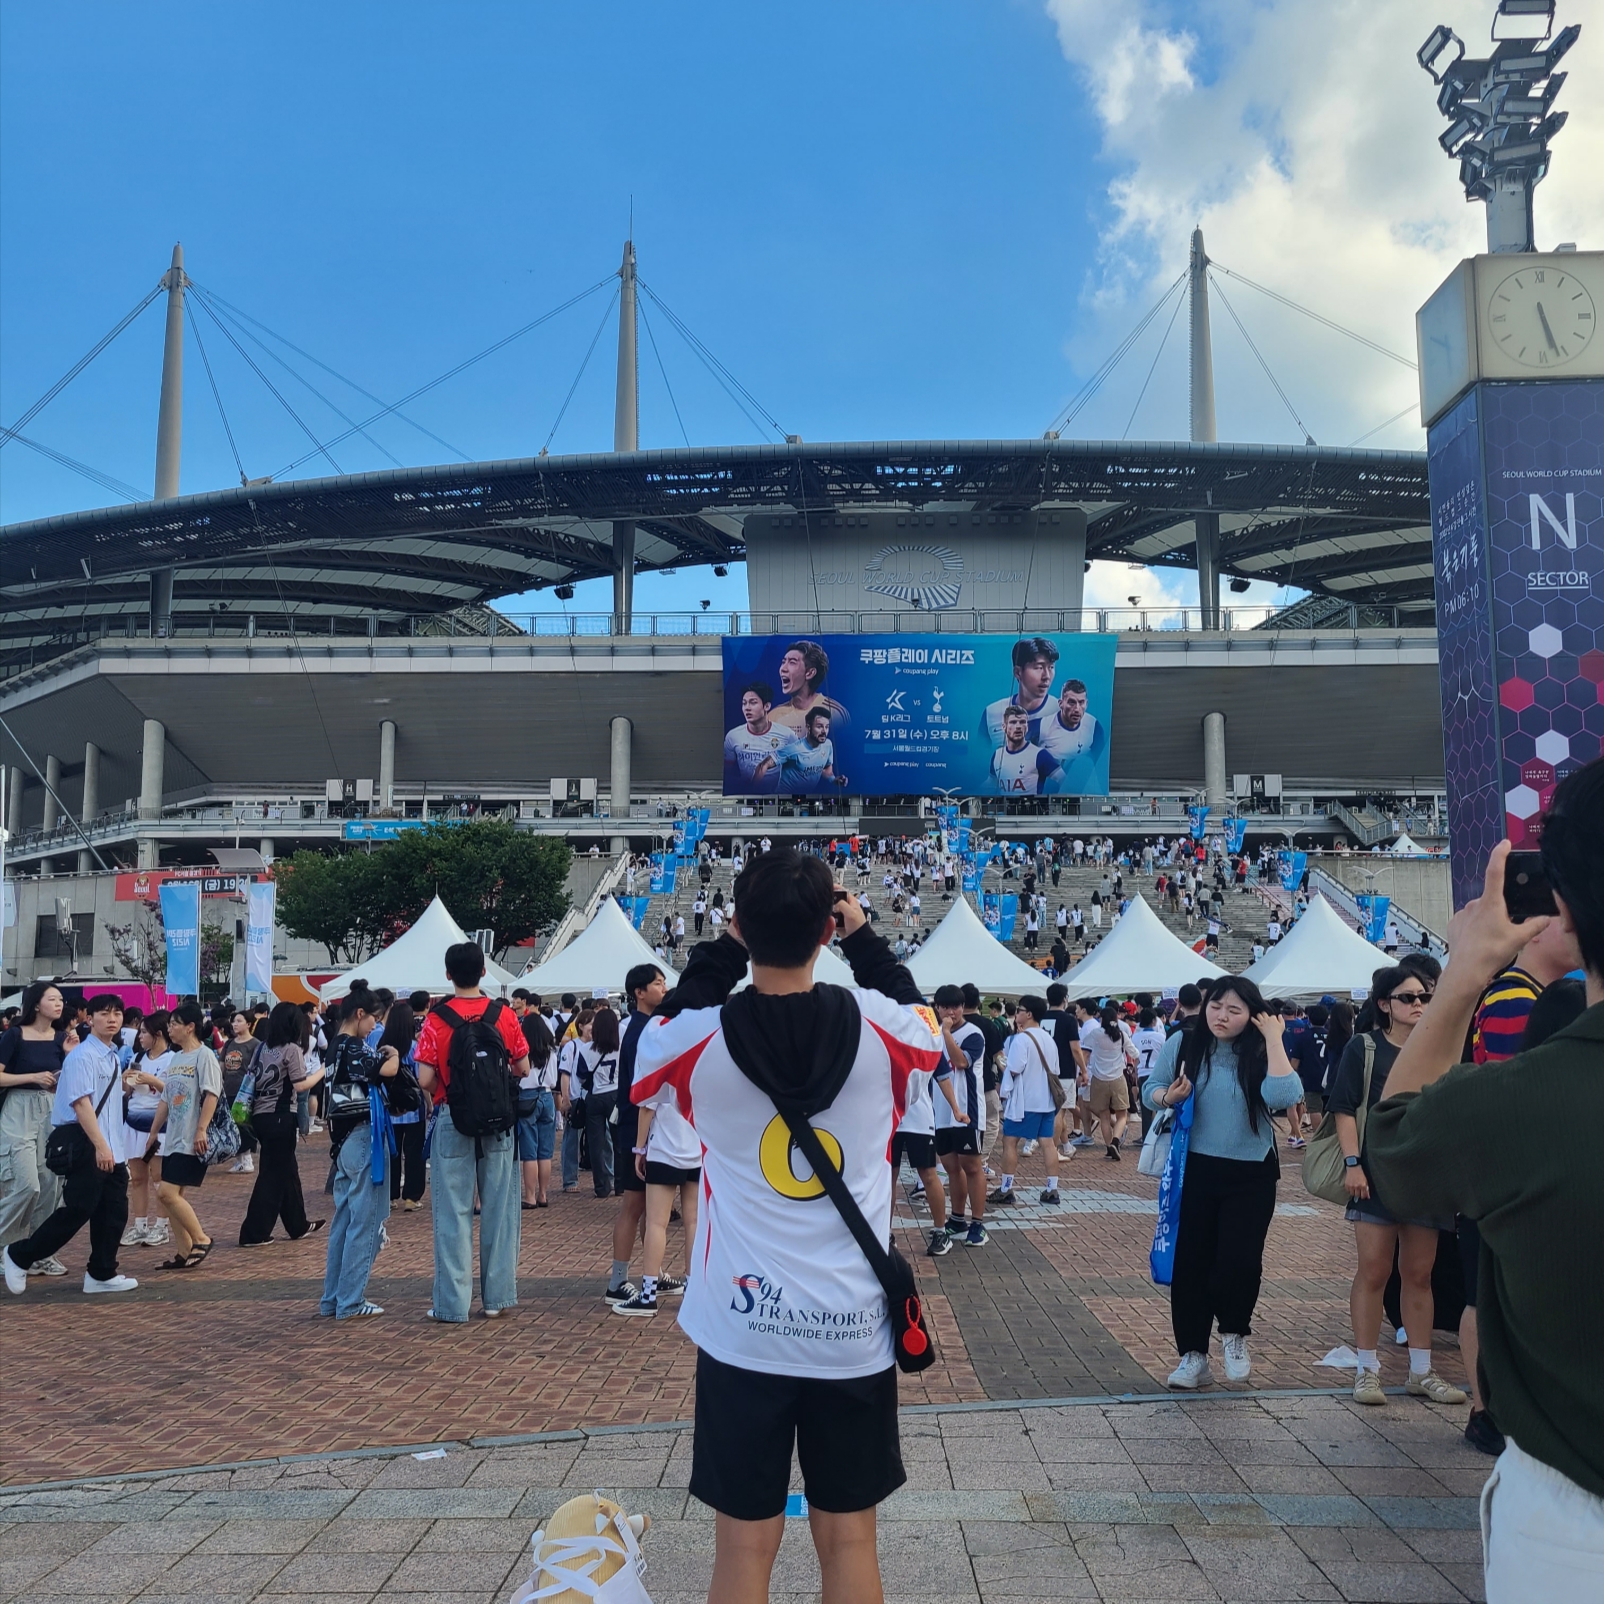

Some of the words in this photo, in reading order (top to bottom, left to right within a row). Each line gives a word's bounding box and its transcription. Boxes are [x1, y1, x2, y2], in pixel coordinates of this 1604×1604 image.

[1502, 471, 1525, 479] SEOUL
[1526, 470, 1553, 478] WORLD
[1554, 469, 1568, 477] CUP
[1570, 468, 1602, 477] STADIUM
[1529, 493, 1577, 550] N
[808, 571, 855, 585] SEOUL
[862, 571, 914, 584] WORLD
[919, 570, 950, 583] CUP
[954, 569, 1025, 583] STADIUM
[1528, 571, 1589, 586] SECTOR
[860, 647, 928, 665] 쿠팡플레이
[931, 649, 975, 664] 시리즈
[881, 714, 889, 723] 팀
[890, 714, 911, 722] K리그
[927, 715, 949, 724] 토트넘
[864, 730, 881, 740] 7월
[884, 729, 907, 739] 31일
[910, 729, 928, 740] (수)
[930, 730, 950, 740] 오후
[952, 731, 969, 741] 8시
[346, 784, 353, 792] H
[1254, 780, 1263, 788] M
[204, 879, 220, 890] (금)
[1316, 1040, 1326, 1058] 7
[1142, 1049, 1153, 1068] 7
[601, 1059, 616, 1084] 7
[748, 1320, 822, 1340] WORLDWIDE
[825, 1327, 873, 1341] EXPRESS
